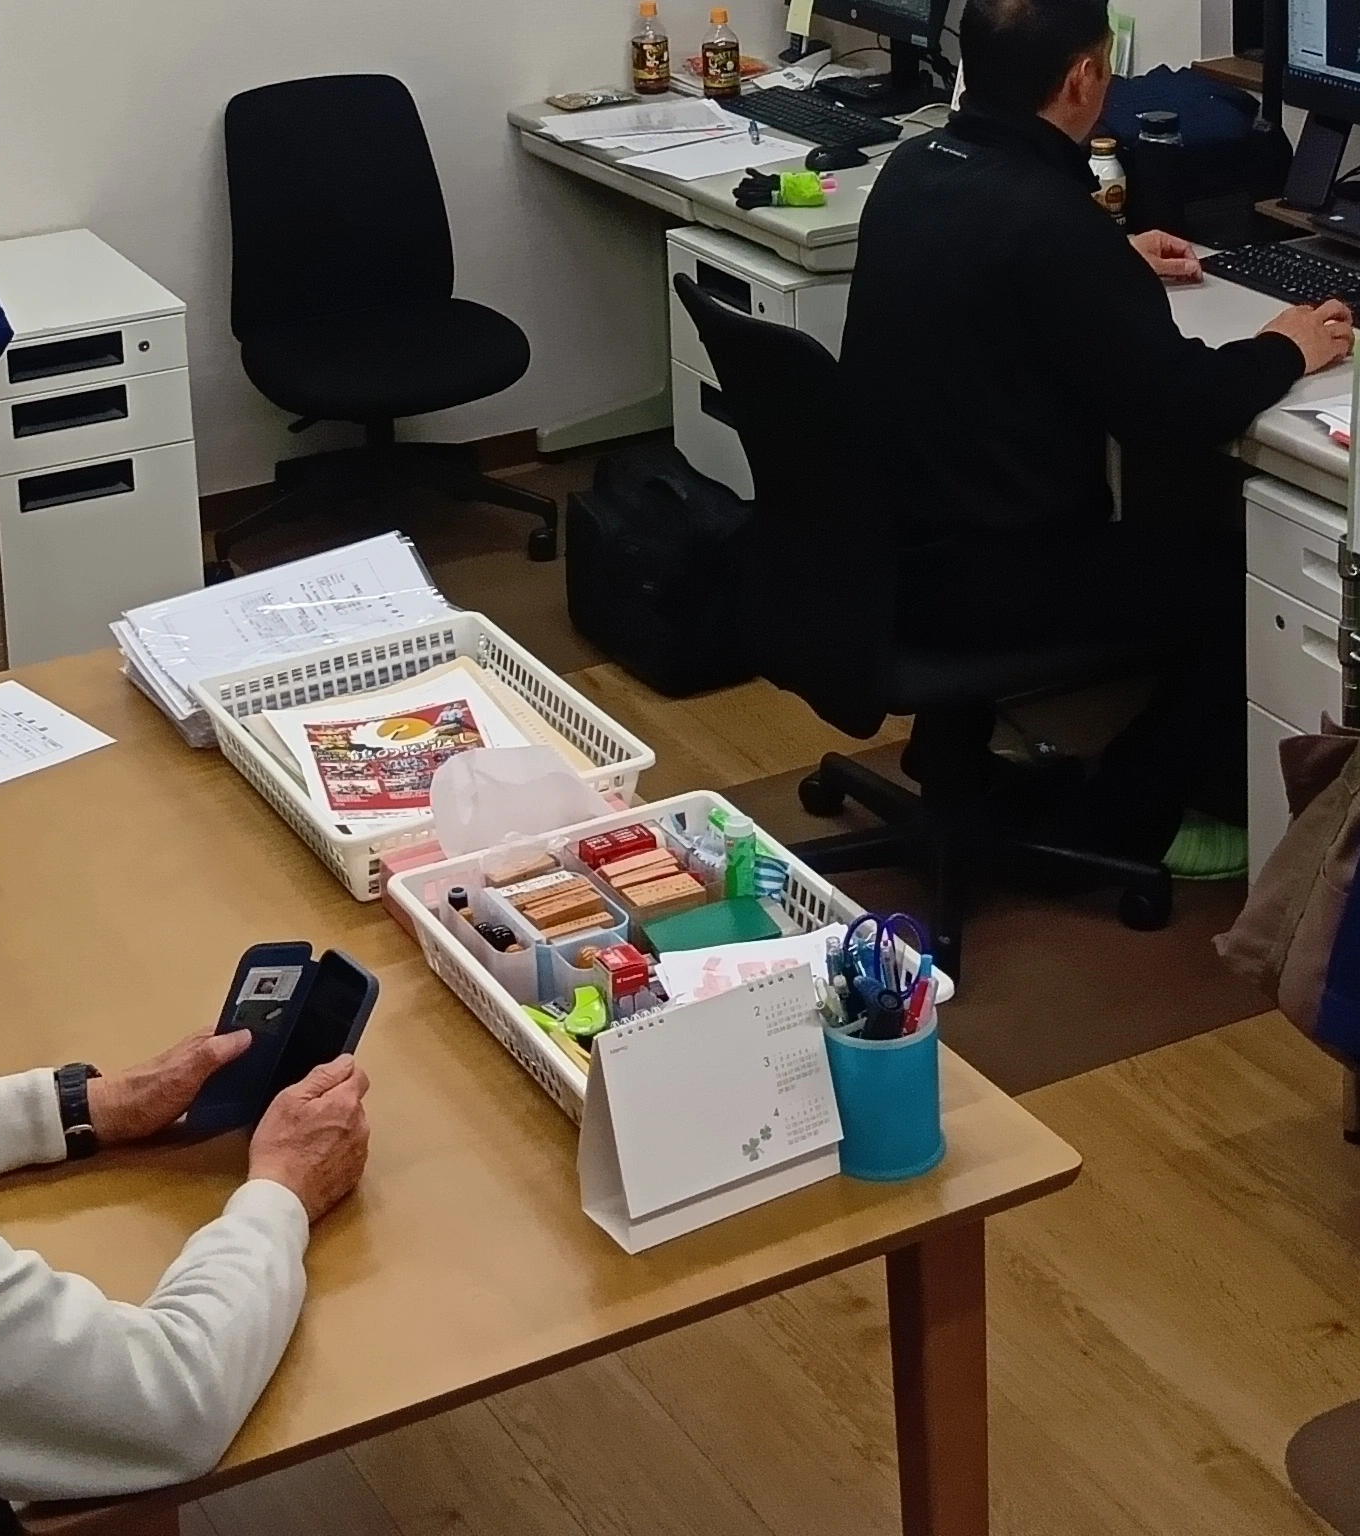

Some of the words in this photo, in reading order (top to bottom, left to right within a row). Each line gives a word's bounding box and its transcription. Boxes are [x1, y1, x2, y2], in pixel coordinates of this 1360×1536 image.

[753, 1005, 760, 1017] 2
[763, 1056, 770, 1068] 3
[773, 1107, 780, 1117] 4
